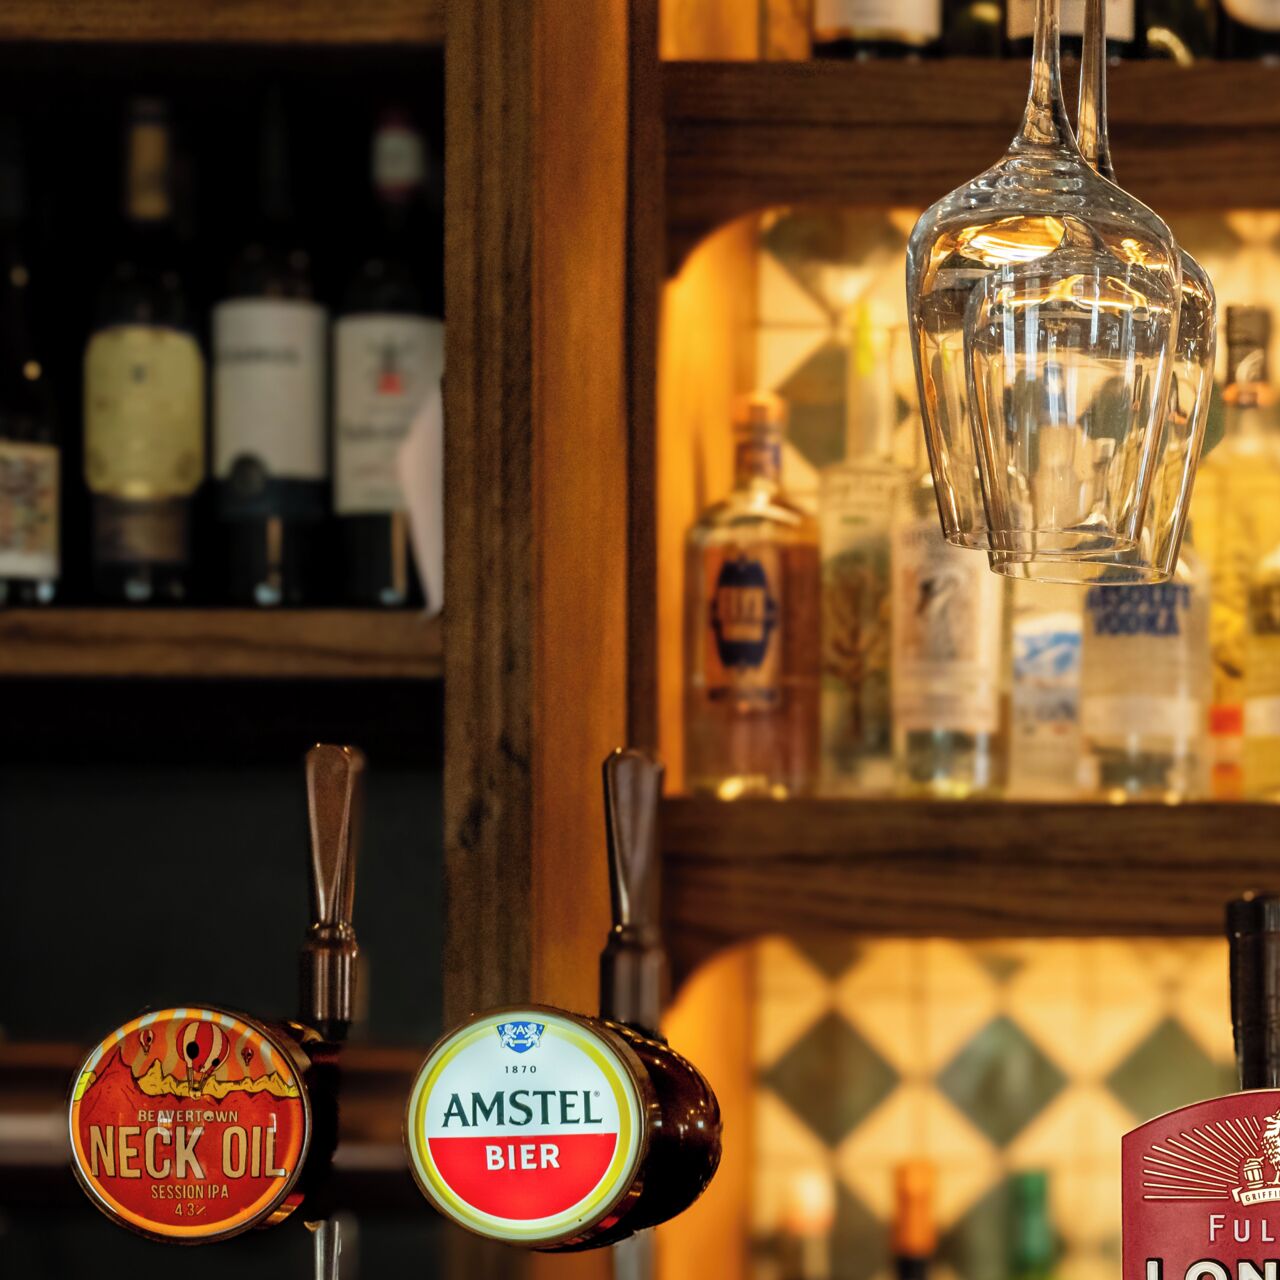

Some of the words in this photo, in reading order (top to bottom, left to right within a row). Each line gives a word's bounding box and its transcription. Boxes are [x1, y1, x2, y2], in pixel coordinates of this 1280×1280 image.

[505, 1065, 537, 1074] 1870
[138, 1110, 239, 1123] BEAVERTOWN
[441, 1090, 603, 1128] AMSTEL
[90, 1126, 206, 1180] NECK
[222, 1126, 288, 1179] OIL
[485, 1143, 560, 1171] BIER
[151, 1184, 205, 1200] SESSION
[207, 1184, 229, 1200] IPA
